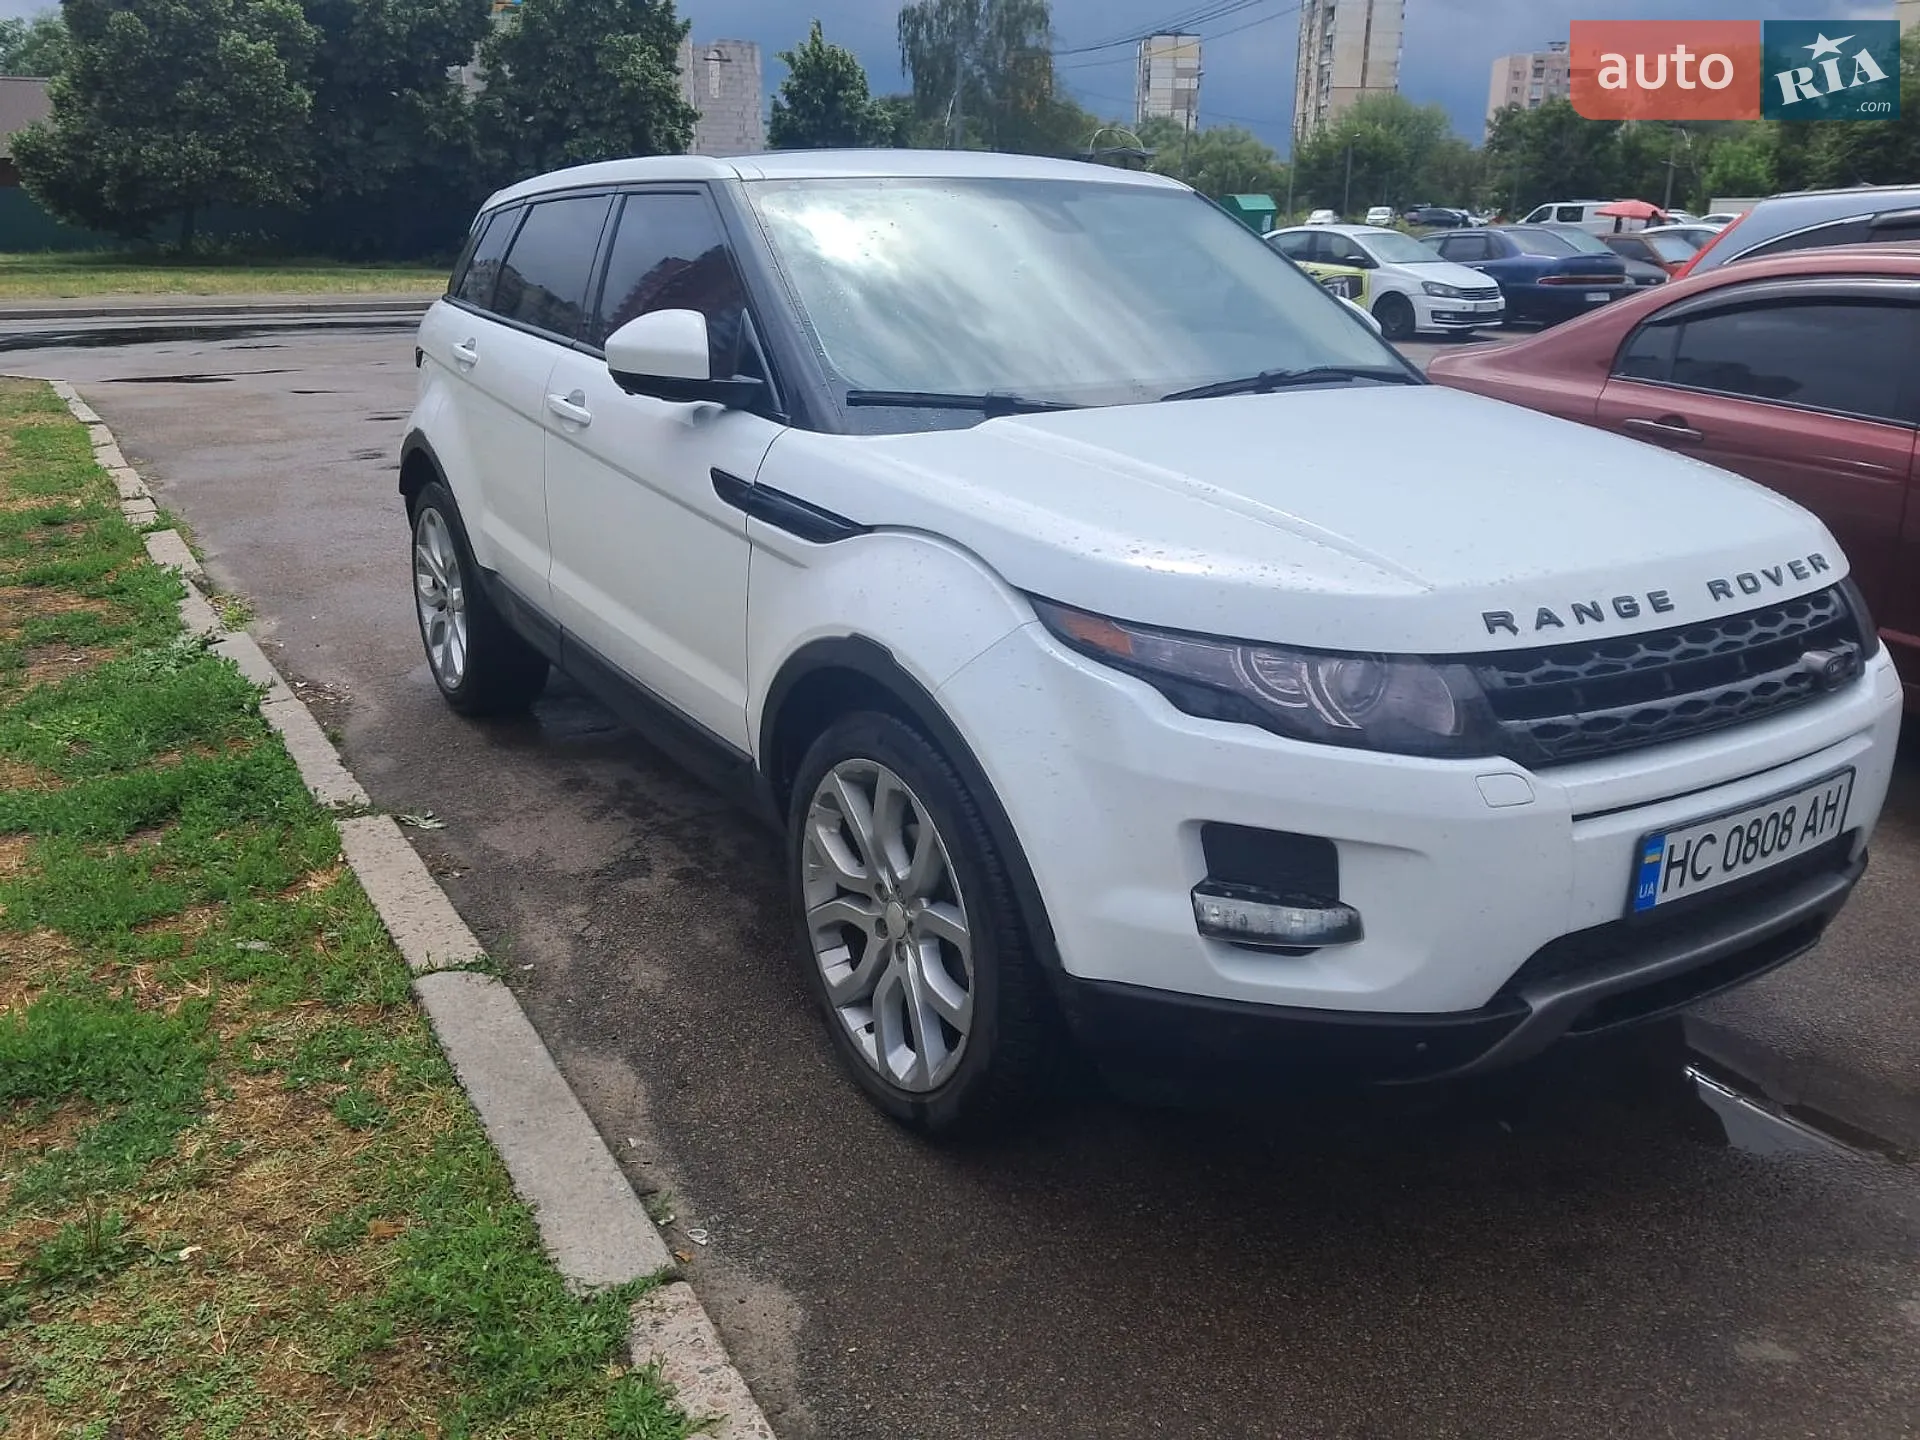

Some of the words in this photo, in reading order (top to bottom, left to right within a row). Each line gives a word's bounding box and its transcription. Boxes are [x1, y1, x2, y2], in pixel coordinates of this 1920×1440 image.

[1482, 590, 1675, 636] RANGE
[1707, 552, 1831, 602] ROVER
[1662, 833, 1717, 893] HC
[1722, 805, 1796, 873] 0808
[1799, 784, 1843, 844] AH
[1638, 883, 1655, 899] UA
